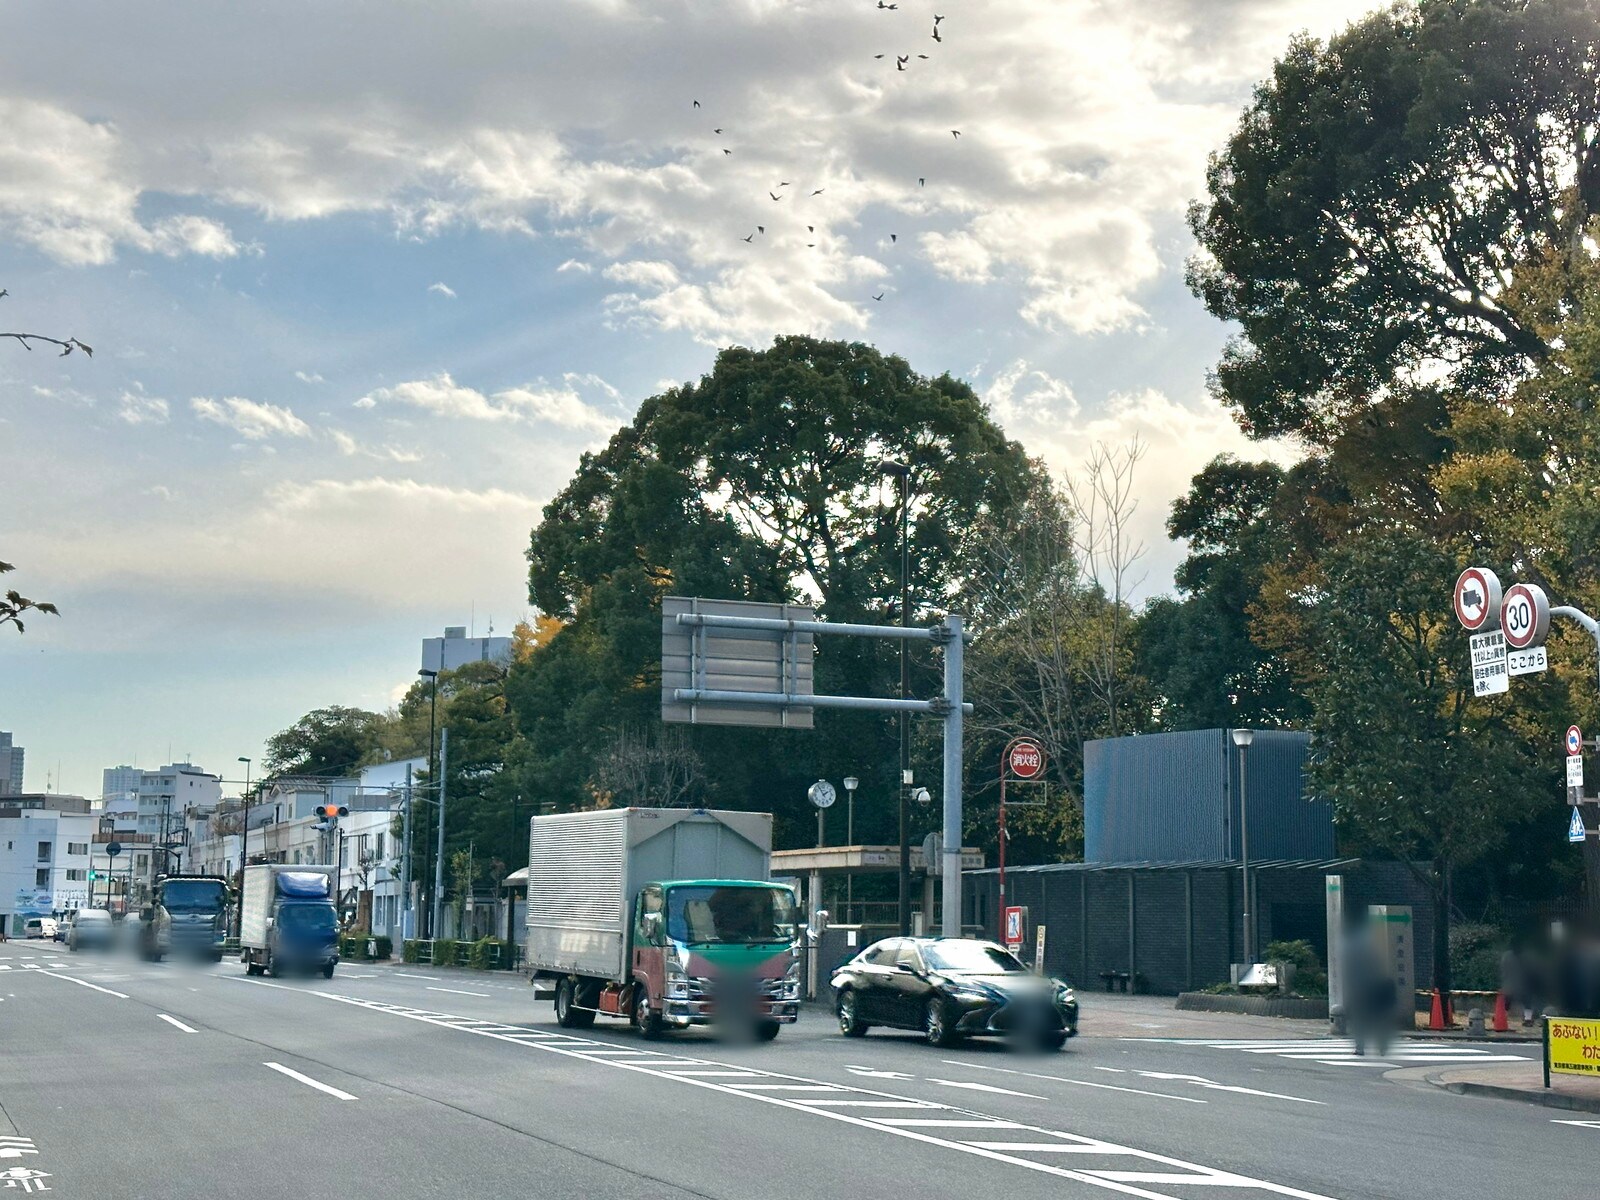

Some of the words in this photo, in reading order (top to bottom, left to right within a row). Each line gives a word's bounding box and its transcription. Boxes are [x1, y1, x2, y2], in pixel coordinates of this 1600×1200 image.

[1509, 602, 1529, 630] 30
[1511, 654, 1544, 669] ここから
[1013, 754, 1038, 766] 消火栓
[1582, 1045, 1600, 1059] わた
